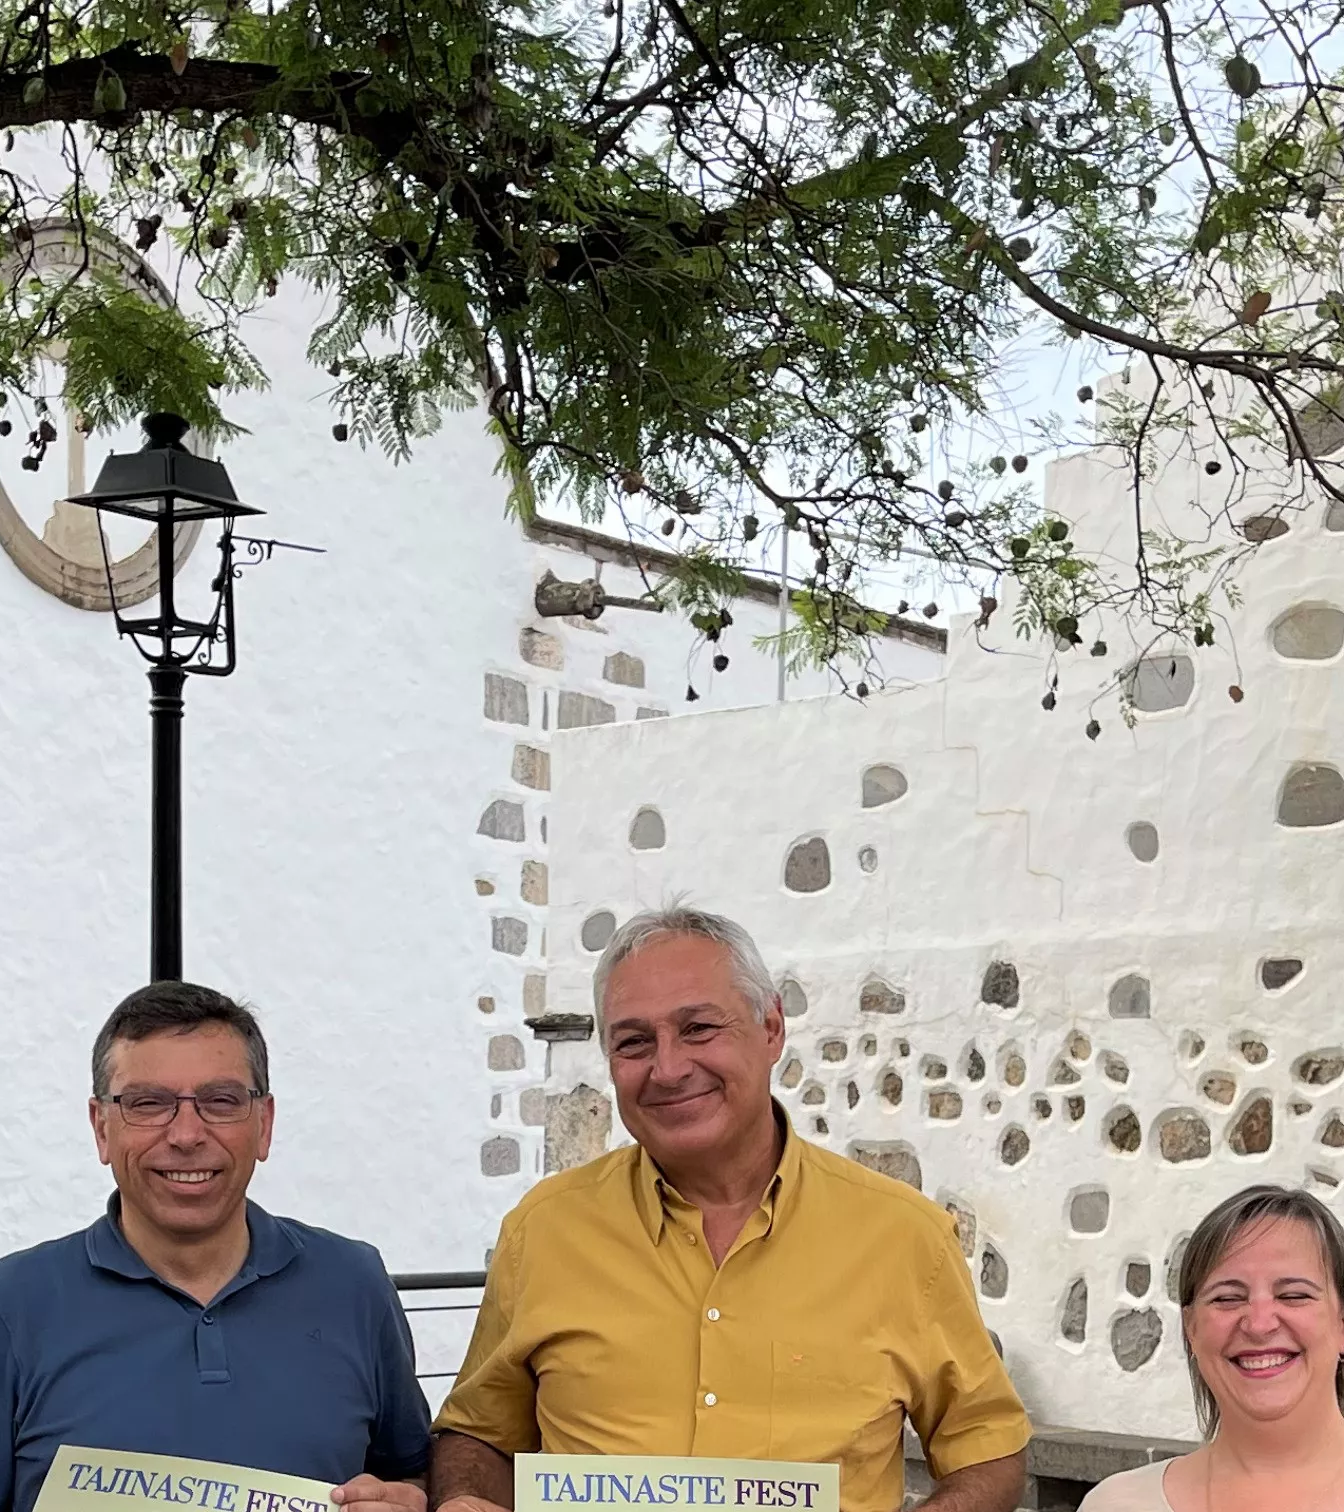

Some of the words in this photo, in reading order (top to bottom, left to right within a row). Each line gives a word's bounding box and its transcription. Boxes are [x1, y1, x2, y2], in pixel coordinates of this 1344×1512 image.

[62, 1458, 240, 1512] TAJINASTE
[535, 1470, 725, 1507] TAJINASTE
[734, 1478, 819, 1508] FEST
